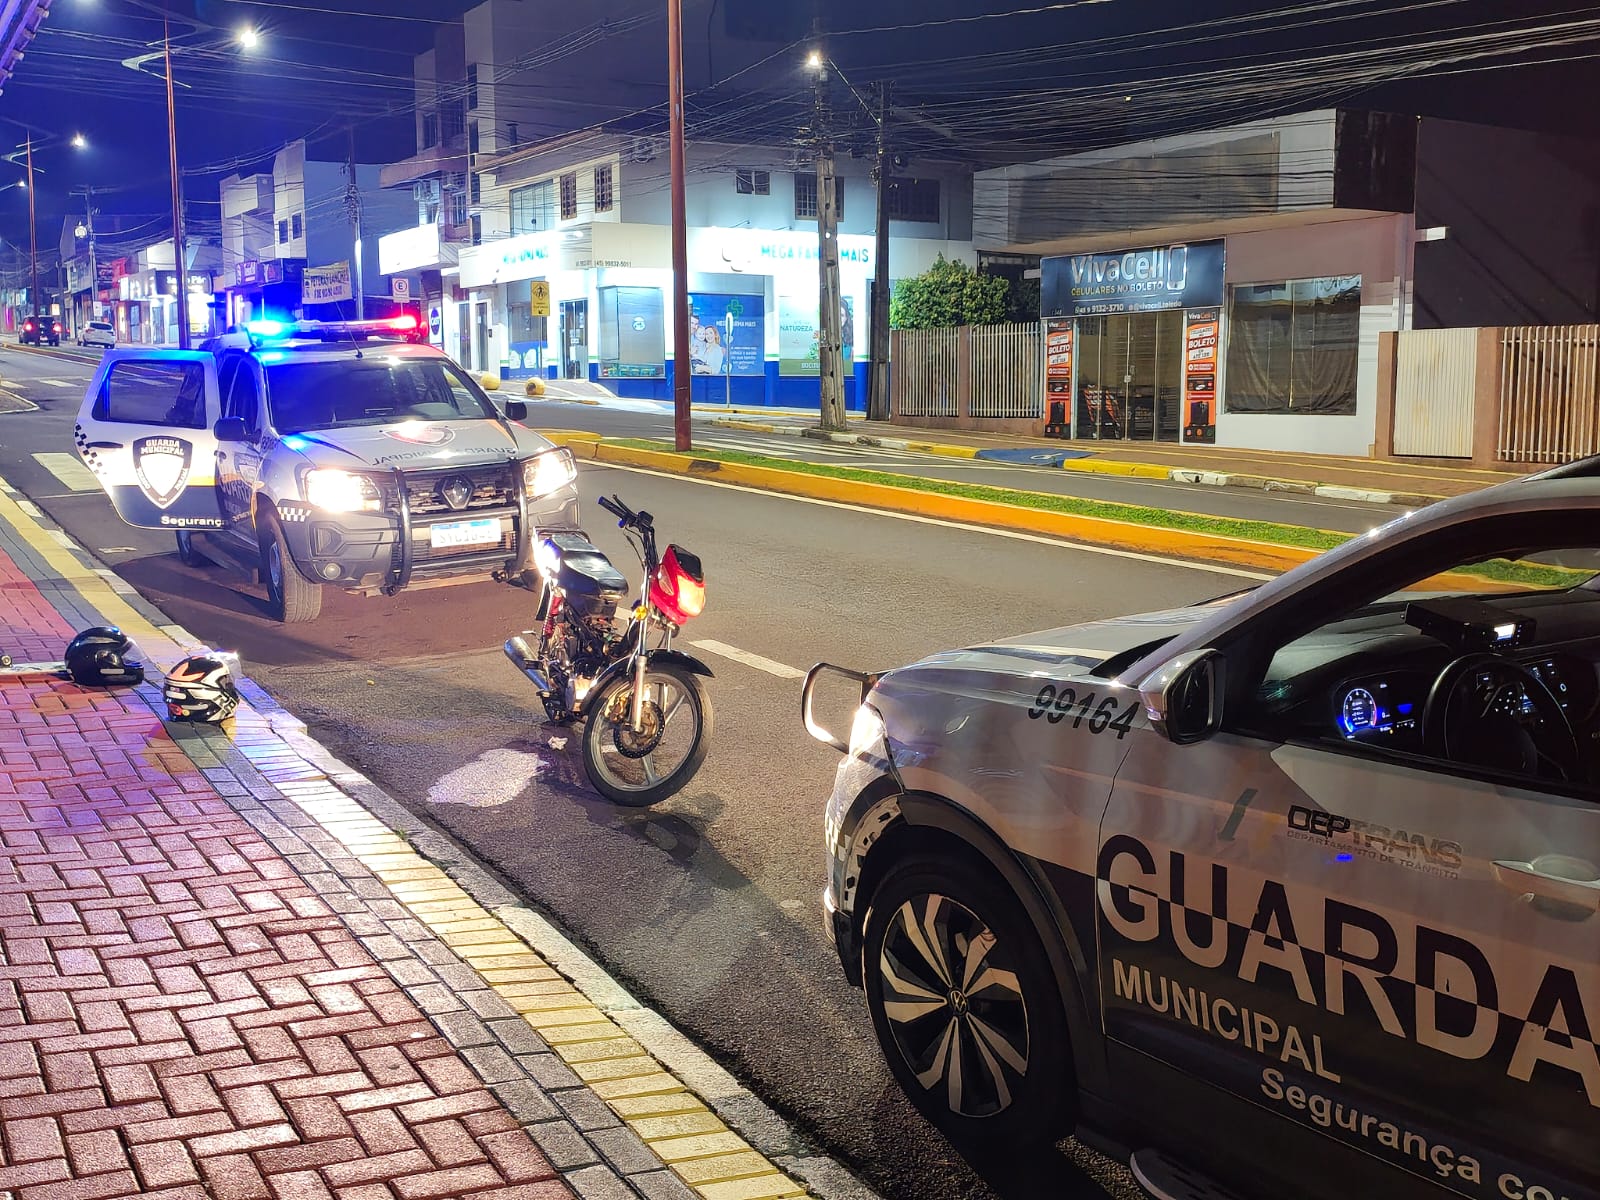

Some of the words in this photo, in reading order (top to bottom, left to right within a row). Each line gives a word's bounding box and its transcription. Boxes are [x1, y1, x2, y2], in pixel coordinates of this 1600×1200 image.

[761, 245, 794, 259] MEGA
[841, 248, 869, 263] MAIS
[1071, 247, 1164, 284] VivaCell
[398, 282, 403, 290] E
[1071, 285, 1115, 296] CELULARES
[1117, 284, 1128, 293] NO
[1130, 280, 1164, 292] BOLETO
[1048, 344, 1070, 355] BOLETO
[1188, 337, 1216, 349] BOLETO
[140, 445, 184, 456] MUNICIPAL
[145, 439, 180, 449] GUARDA
[160, 515, 225, 527] Seguranç
[1028, 684, 1140, 739] 99164
[1287, 804, 1463, 869] DEPTRANS
[1286, 830, 1376, 860] DEPARTAMENTO
[1379, 854, 1396, 864] DE
[1097, 834, 1600, 1107] GUARDA
[1112, 958, 1341, 1083] MUNICIPAL
[1260, 1067, 1481, 1185] Segurança
[1497, 1172, 1573, 1200] co
